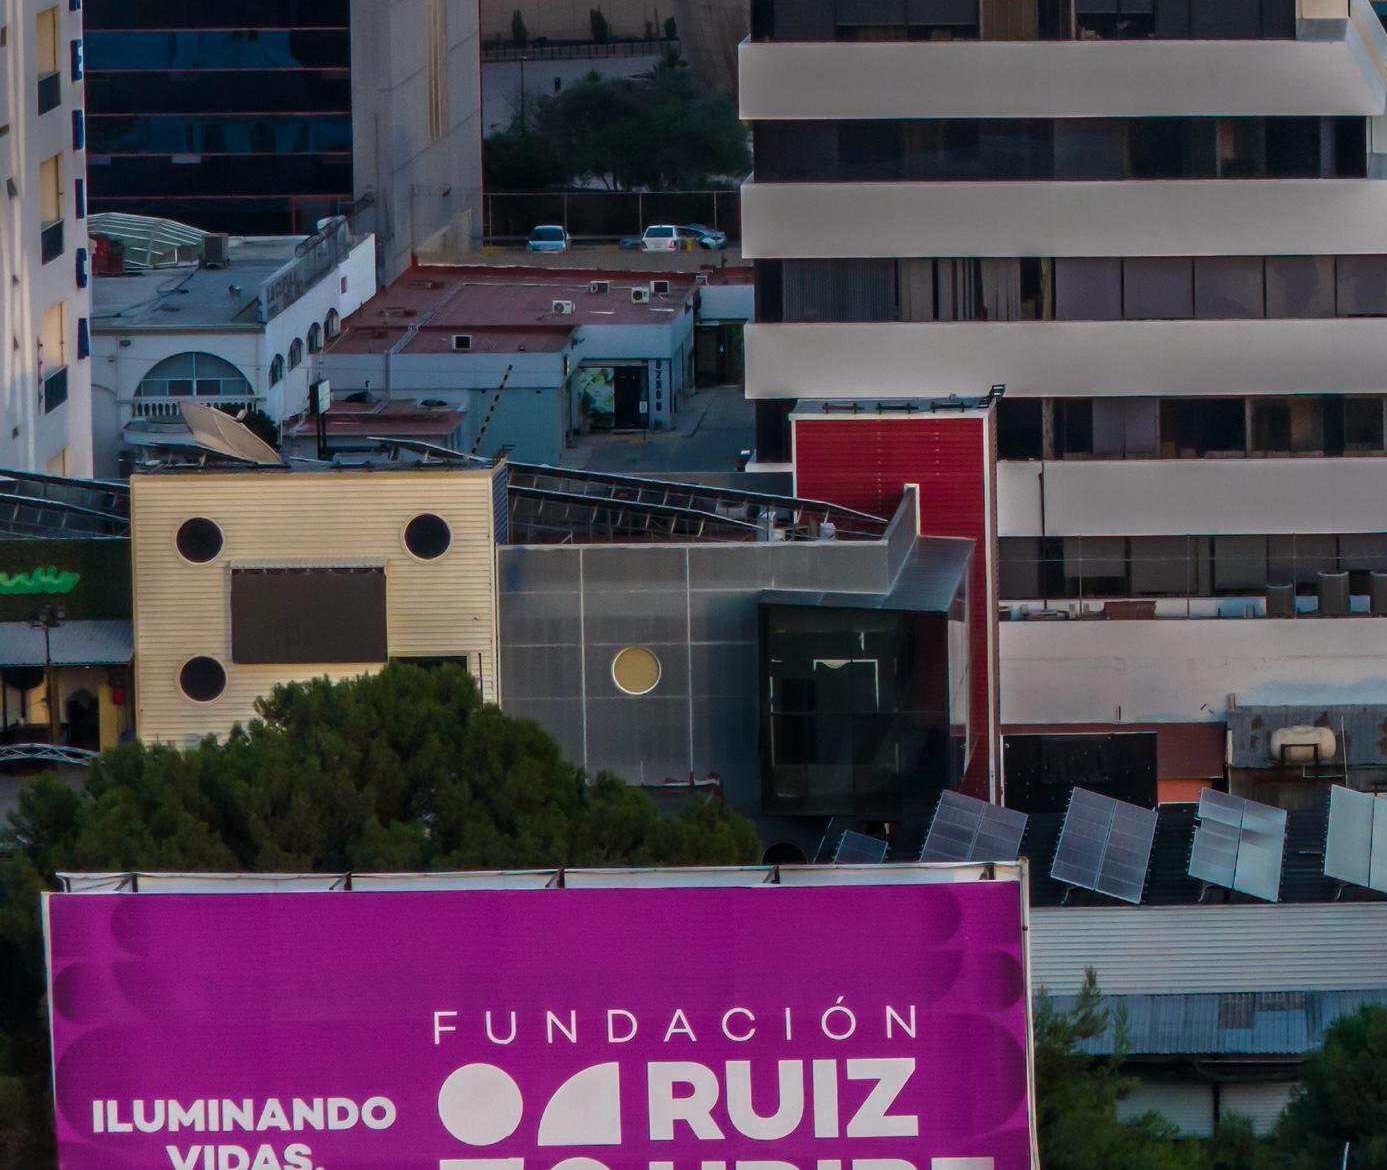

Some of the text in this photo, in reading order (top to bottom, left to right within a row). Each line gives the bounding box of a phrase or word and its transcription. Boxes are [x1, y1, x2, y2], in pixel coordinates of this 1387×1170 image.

[433, 996, 919, 1044] FUNDACIÓN
[92, 1096, 397, 1133] ILUMINANDO
[647, 1057, 920, 1141] RUIZ
